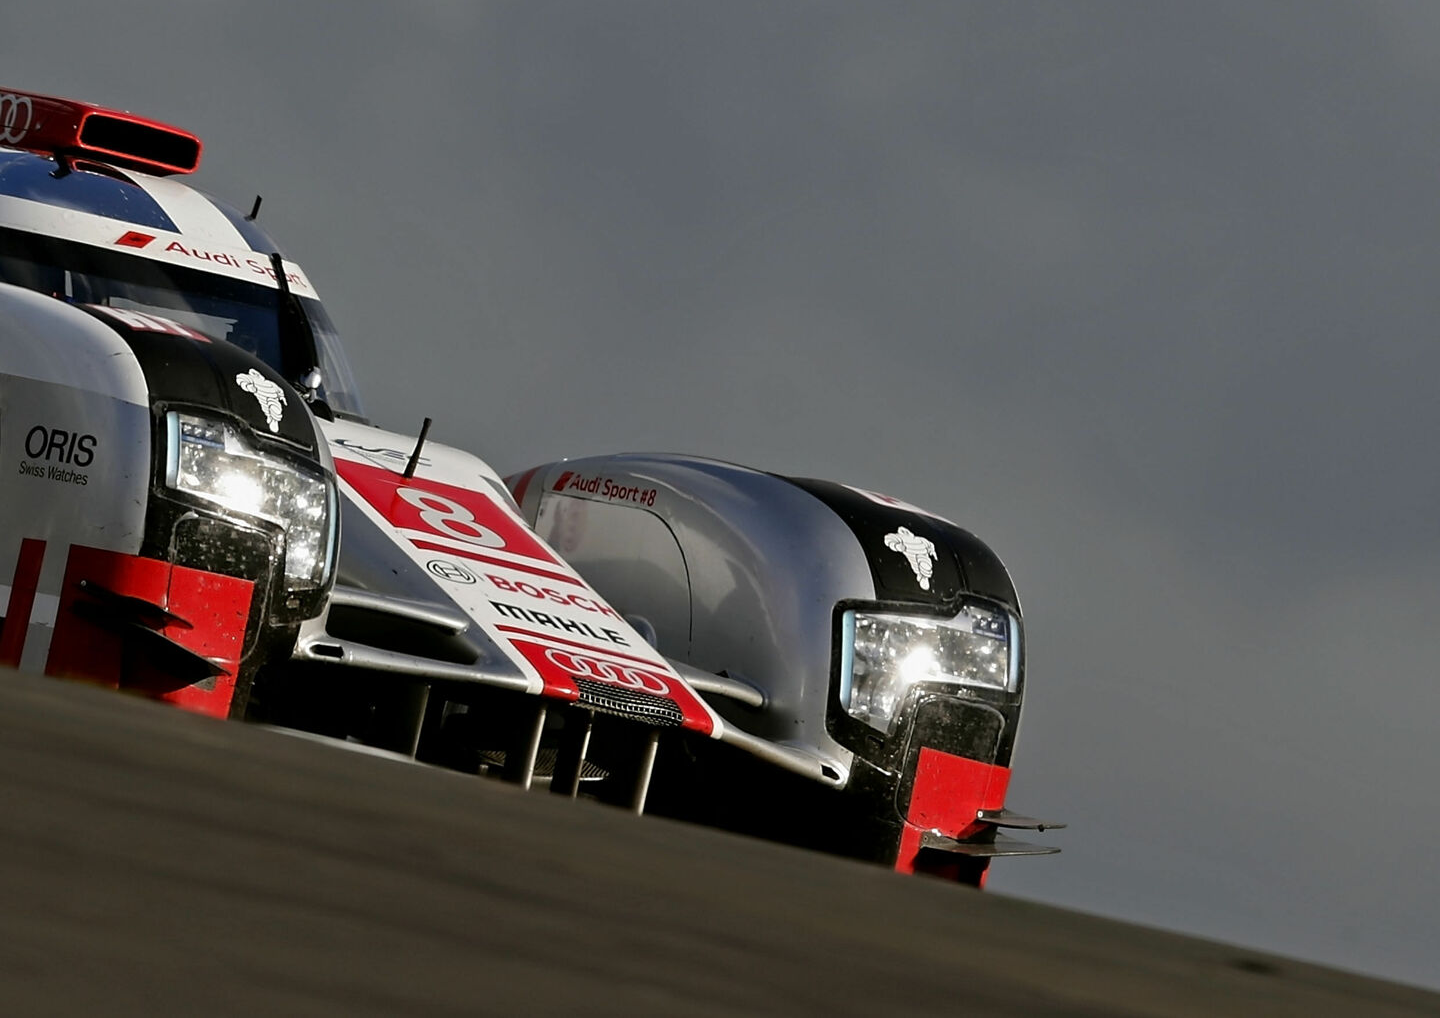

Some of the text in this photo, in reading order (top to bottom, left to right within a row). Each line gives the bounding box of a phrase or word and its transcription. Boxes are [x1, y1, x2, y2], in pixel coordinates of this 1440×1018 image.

[164, 241, 241, 269] Audi
[24, 425, 97, 467] ORIS
[18, 460, 89, 486] Swiss Watches
[568, 474, 658, 509] Audi Sport #8
[395, 486, 507, 549] 8
[484, 572, 626, 623] BOSCH
[488, 599, 632, 648] MAHLE
